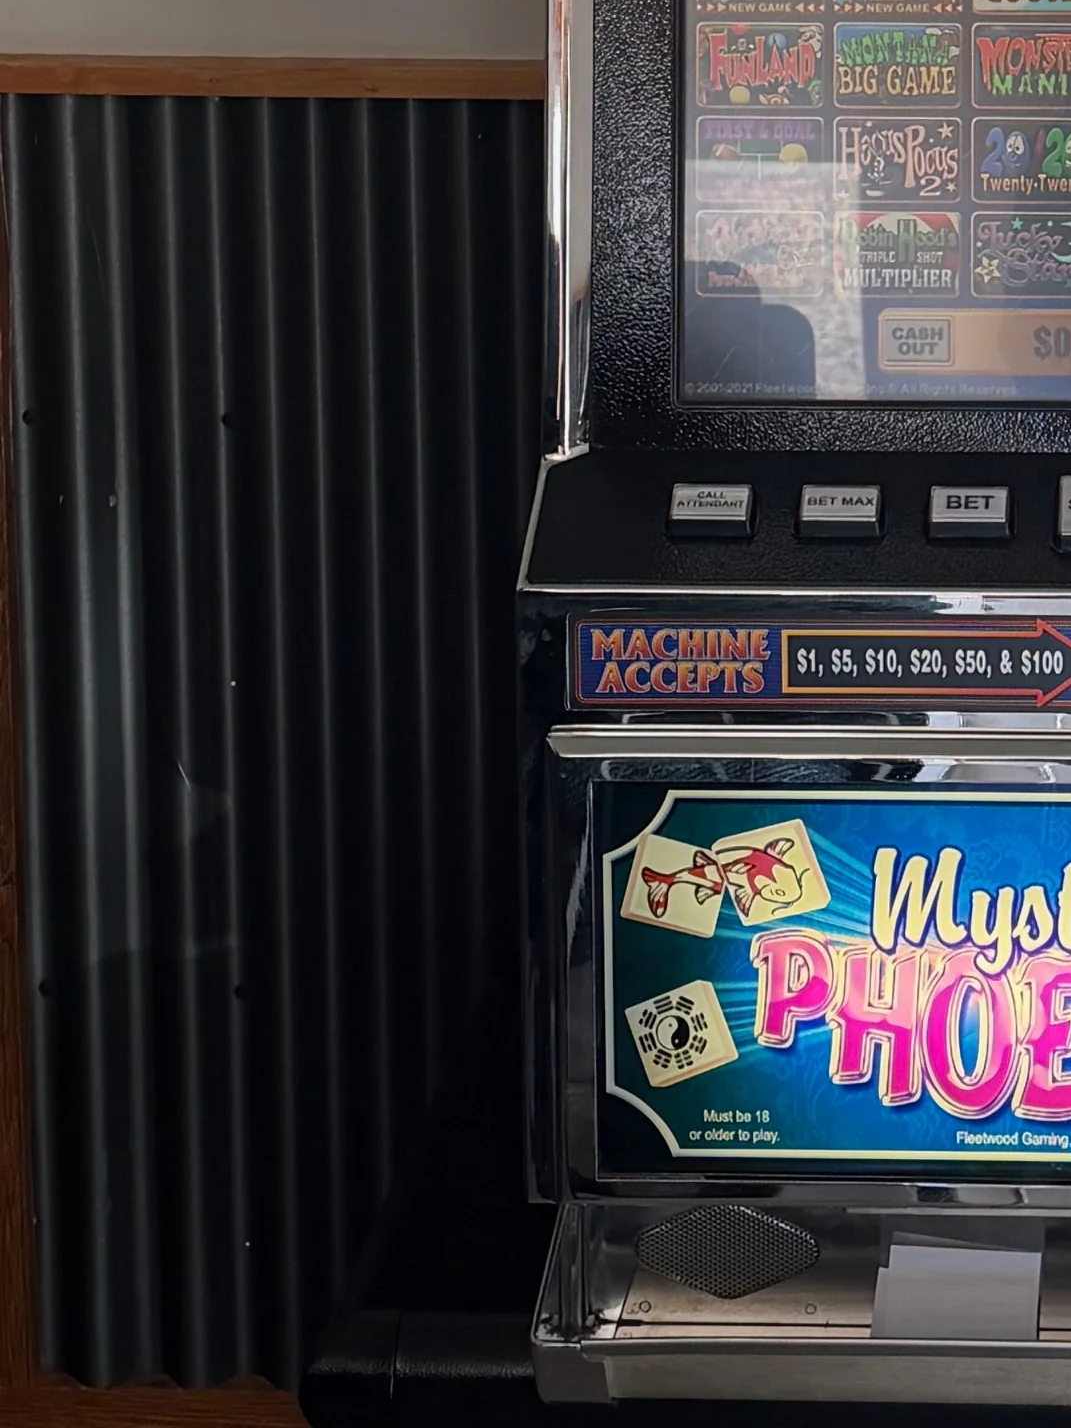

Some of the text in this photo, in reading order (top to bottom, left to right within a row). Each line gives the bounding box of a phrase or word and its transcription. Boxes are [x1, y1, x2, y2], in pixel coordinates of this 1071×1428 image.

[728, 3, 792, 12] NEW GAME
[866, 3, 930, 13] NEW GAME
[838, 65, 957, 95] BIG GAME
[703, 121, 754, 140] FIRST
[919, 175, 941, 196] 2
[844, 268, 952, 288] MULTIPLIER
[891, 327, 944, 341] CASH
[898, 342, 939, 356] OUT
[697, 491, 727, 500] CALL
[807, 496, 876, 508] BET MAX
[945, 494, 995, 511] BET
[677, 499, 745, 509] ATTENDANT
[590, 629, 772, 662] MACHINE
[797, 648, 1064, 678] $1, $5, $10, $20, $50, & $100
[596, 661, 765, 695] ACCEPTS
[703, 1109, 770, 1123] Must be 18
[688, 1128, 780, 1145] or older to play.
[956, 1131, 1018, 1146] Fleetwood
